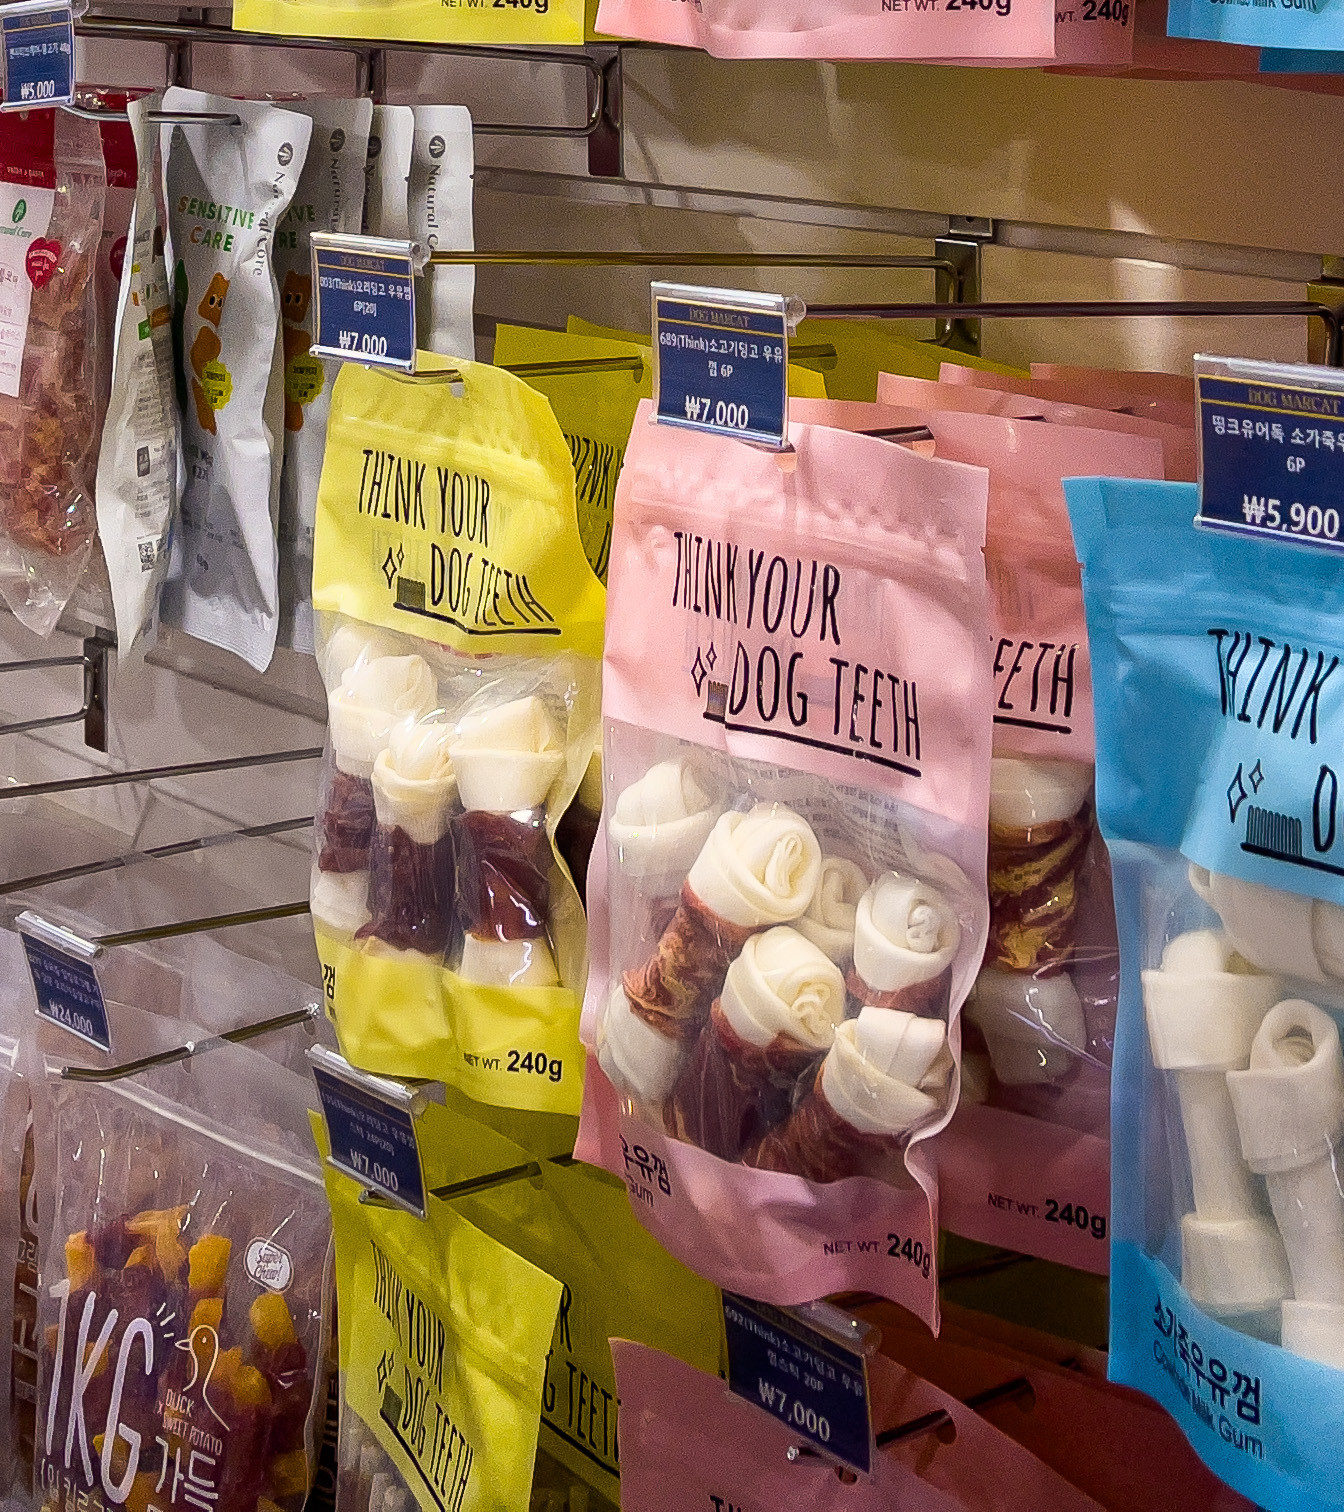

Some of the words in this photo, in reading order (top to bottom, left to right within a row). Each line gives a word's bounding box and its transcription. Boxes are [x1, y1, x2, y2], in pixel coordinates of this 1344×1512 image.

[177, 195, 254, 230] SENSITIVE
[191, 226, 233, 252] CARE
[358, 449, 427, 531] THINK
[436, 465, 490, 547] YOUR
[1286, 456, 1306, 472] 6P
[431, 542, 473, 615] DOG
[475, 557, 555, 626] TEETH
[672, 532, 739, 625] THINK
[745, 545, 841, 645] YOUR
[728, 642, 809, 728] DOG
[830, 656, 922, 761] TEETH
[990, 635, 1079, 719] EETH
[1208, 627, 1339, 746] THINK
[506, 1049, 563, 1082] 240g
[887, 1233, 931, 1279] 240g
[988, 1192, 1012, 1213] NET
[1044, 1199, 1106, 1239] 240g
[370, 1238, 403, 1347] THINK
[407, 1289, 445, 1394] YOUR
[46, 1278, 154, 1504] 1KG
[165, 1388, 194, 1419] DUCK
[402, 1364, 431, 1459] DOG
[1219, 1417, 1264, 1458] Gum
